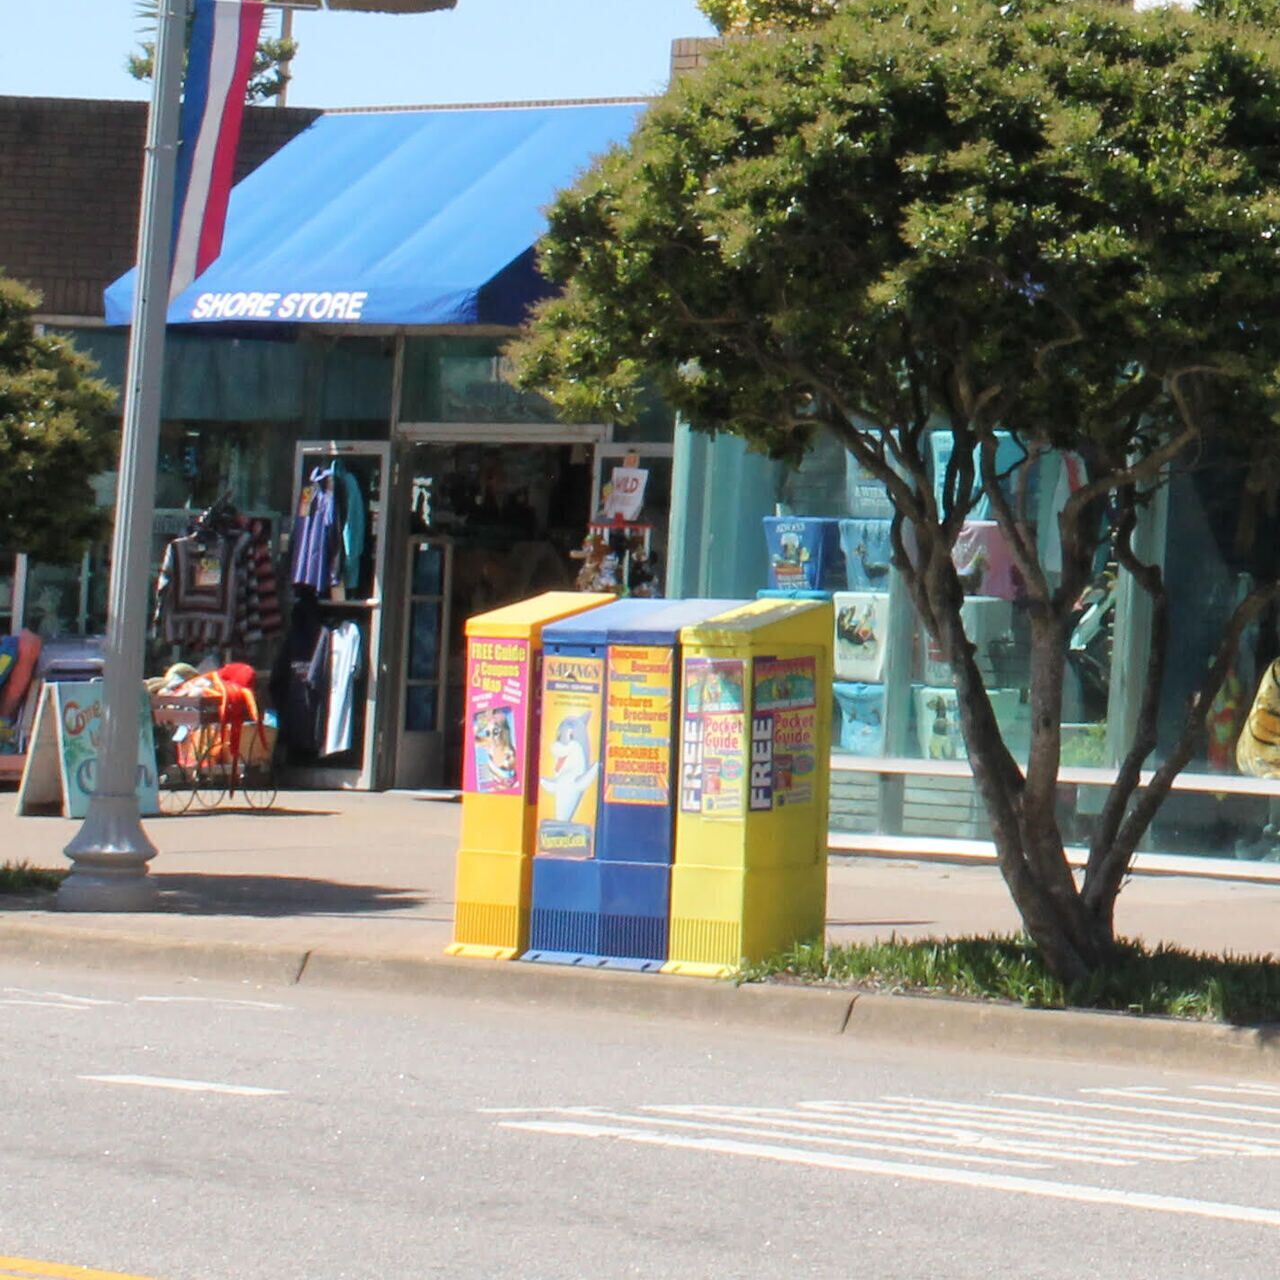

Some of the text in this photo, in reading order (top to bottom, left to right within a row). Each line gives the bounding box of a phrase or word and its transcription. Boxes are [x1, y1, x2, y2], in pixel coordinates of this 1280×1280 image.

[192, 291, 367, 319] SHORE STORE
[471, 642, 526, 662] FREE Guide
[703, 717, 743, 734] Pocket
[774, 714, 815, 731] Pocket
[703, 733, 739, 749] Guide
[774, 730, 811, 745] Guide
[682, 719, 703, 810] FREE
[751, 719, 773, 810] FREE
